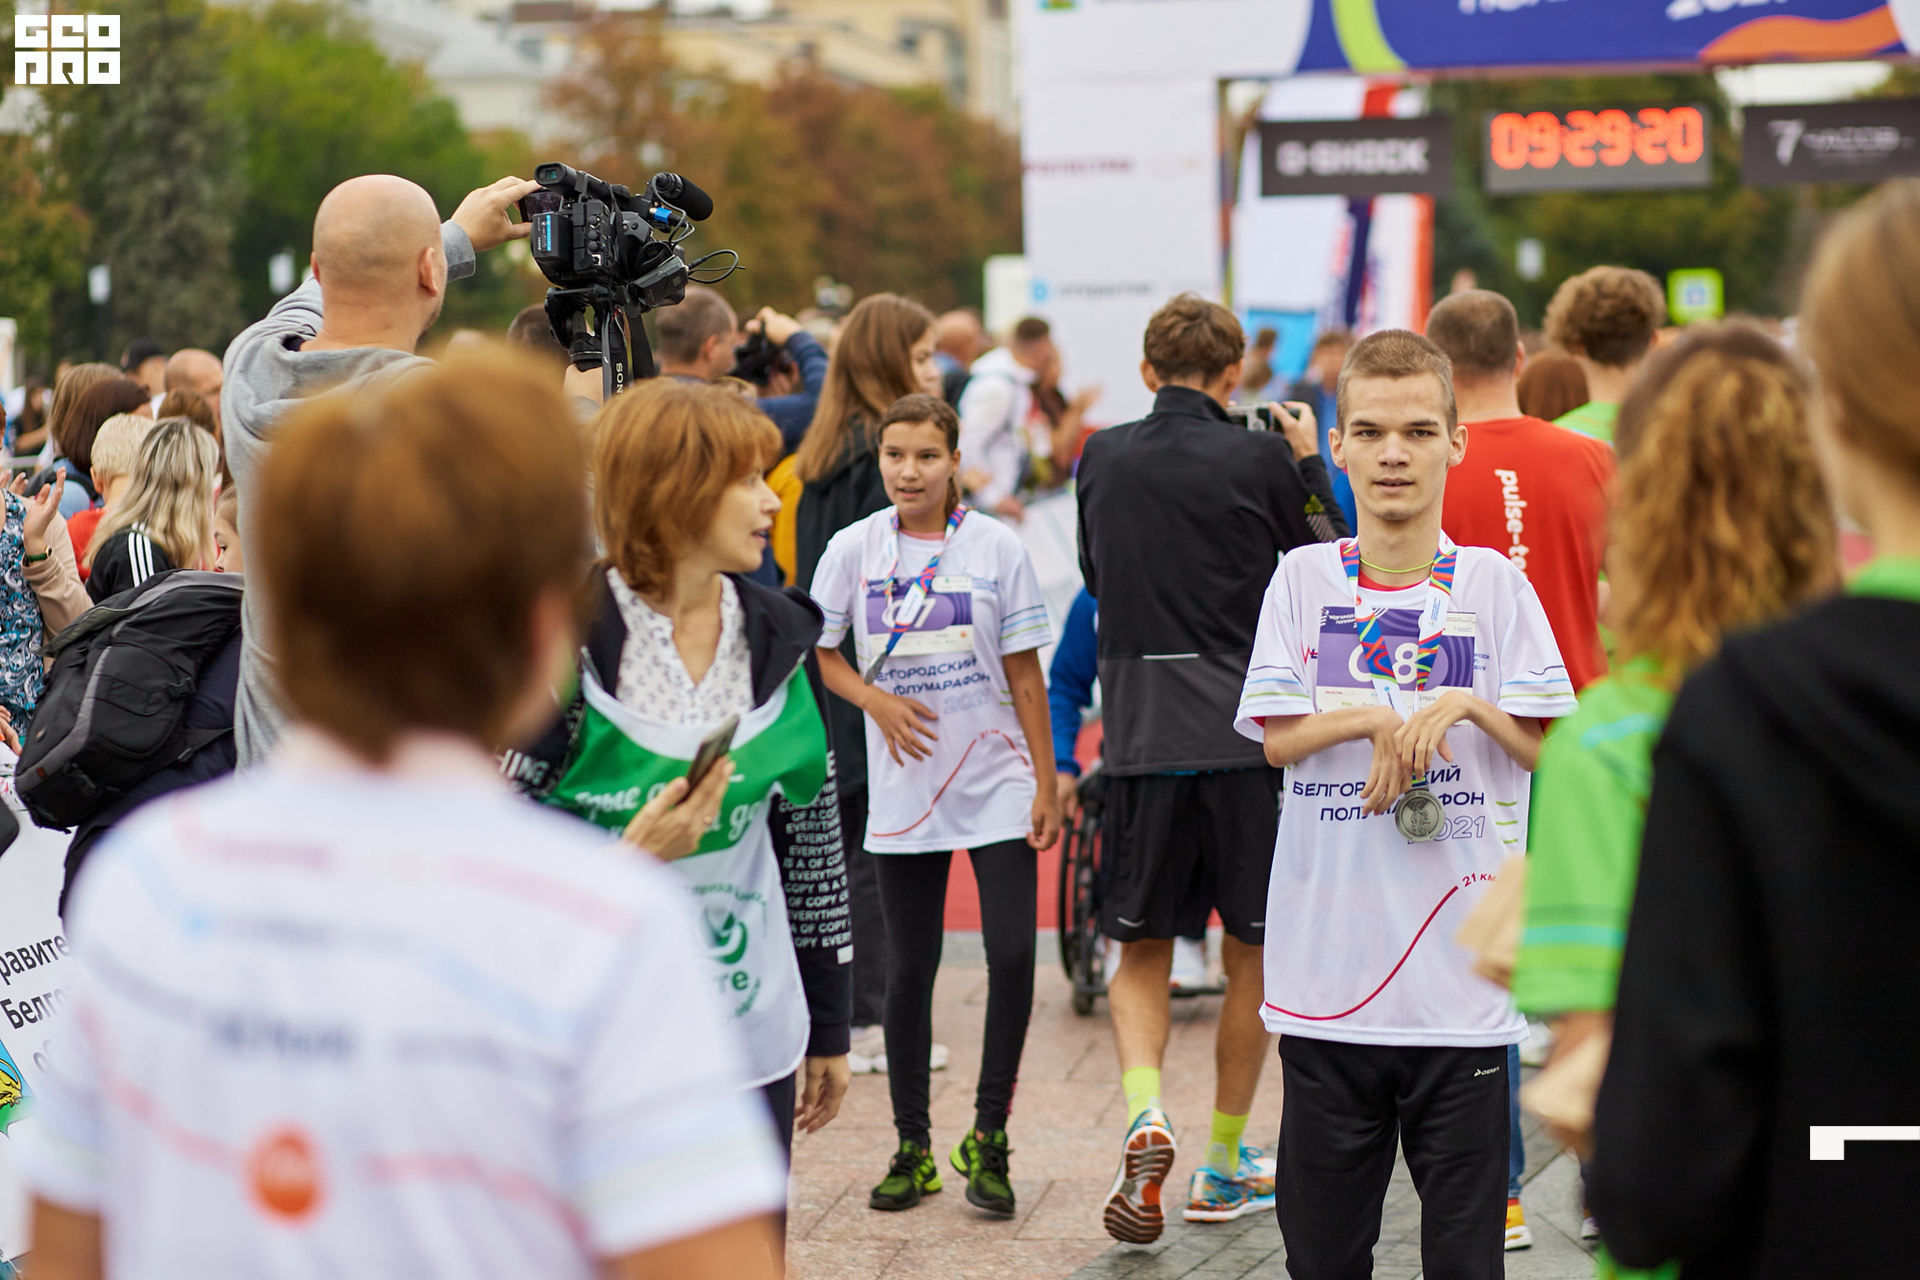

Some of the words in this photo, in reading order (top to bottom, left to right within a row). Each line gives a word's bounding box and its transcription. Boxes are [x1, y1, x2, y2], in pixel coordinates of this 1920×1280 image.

[1767, 119, 1804, 166] 7
[1276, 138, 1428, 177] G-SHOCK
[1494, 469, 1529, 580] pulse-te
[1292, 765, 1461, 797] БЕЛГОРКИЙ
[1320, 792, 1485, 821] ПОЛУФОН
[1408, 815, 1486, 845] 021
[796, 858, 805, 869] A
[808, 857, 824, 869] OF
[784, 882, 815, 894] COPY
[818, 882, 830, 893] IS
[832, 880, 841, 890] A
[1462, 873, 1477, 888] 21
[788, 896, 803, 907] OF
[805, 894, 837, 908] COPY
[800, 923, 815, 934] OF
[818, 918, 847, 933] COPY
